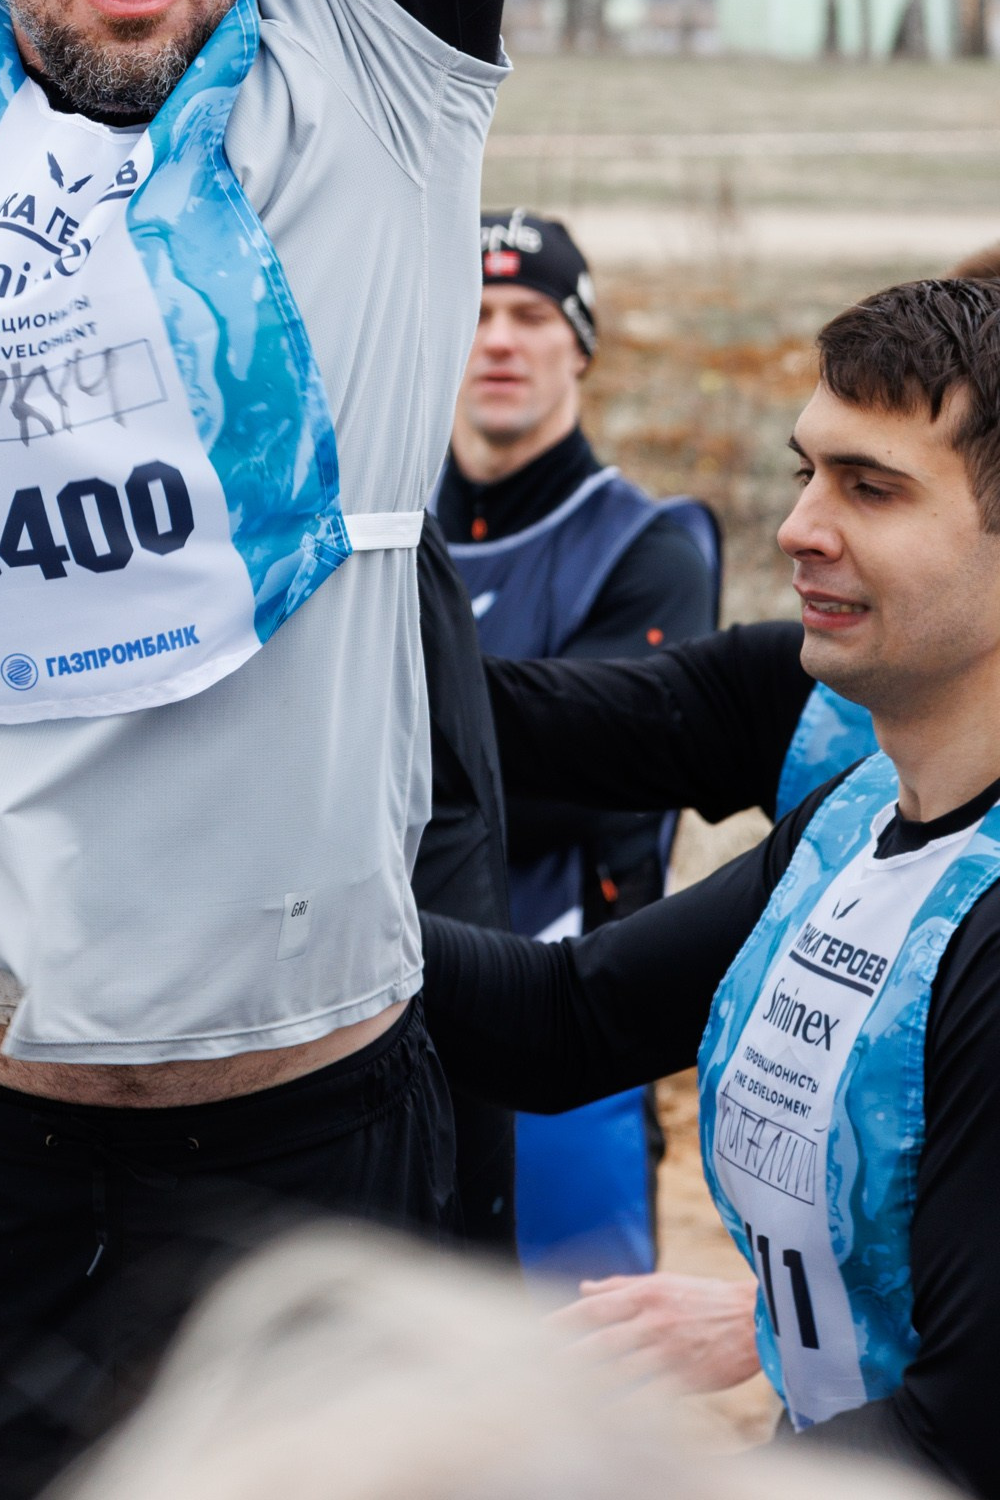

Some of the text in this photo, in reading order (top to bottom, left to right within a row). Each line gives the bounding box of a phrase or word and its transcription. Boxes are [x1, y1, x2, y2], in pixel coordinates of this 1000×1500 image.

[45, 624, 201, 678] ГАЗПРОМБАНК
[812, 932, 889, 986] ГЕРОЕВ
[762, 977, 840, 1052] Sminex
[733, 1069, 812, 1120] FINE DEVELOPMENT
[743, 1045, 820, 1095] ПЕРФЕКЦИОНИСТЫ
